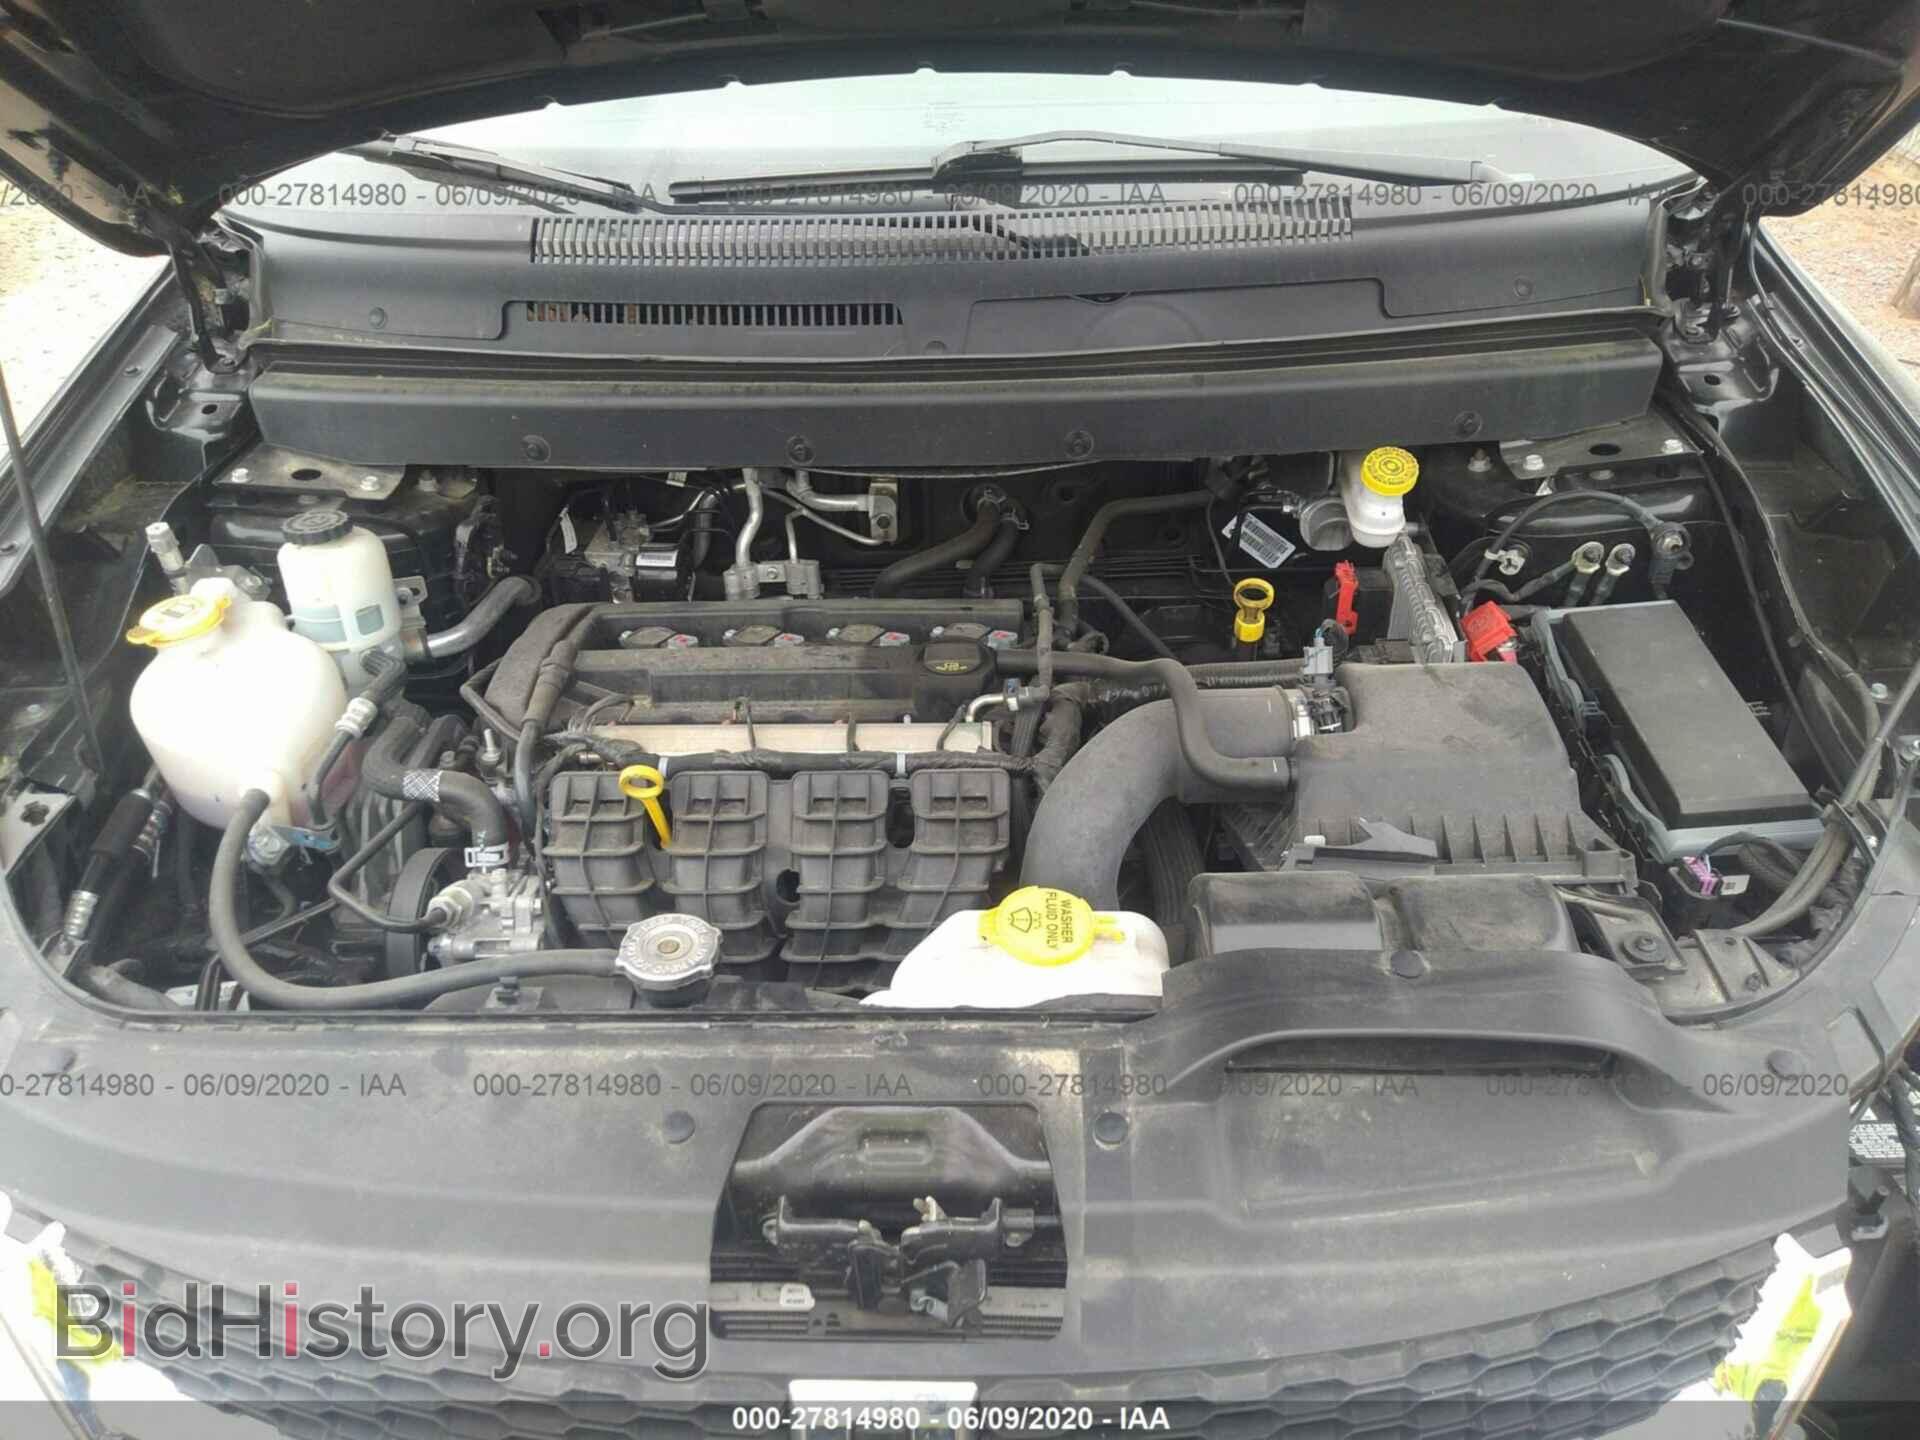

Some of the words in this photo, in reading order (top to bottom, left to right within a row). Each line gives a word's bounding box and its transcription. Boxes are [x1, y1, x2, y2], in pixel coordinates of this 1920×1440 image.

[1046, 892, 1058, 921] FLUID
[1060, 899, 1074, 943] WASHER
[1046, 924, 1058, 950] ONLY
